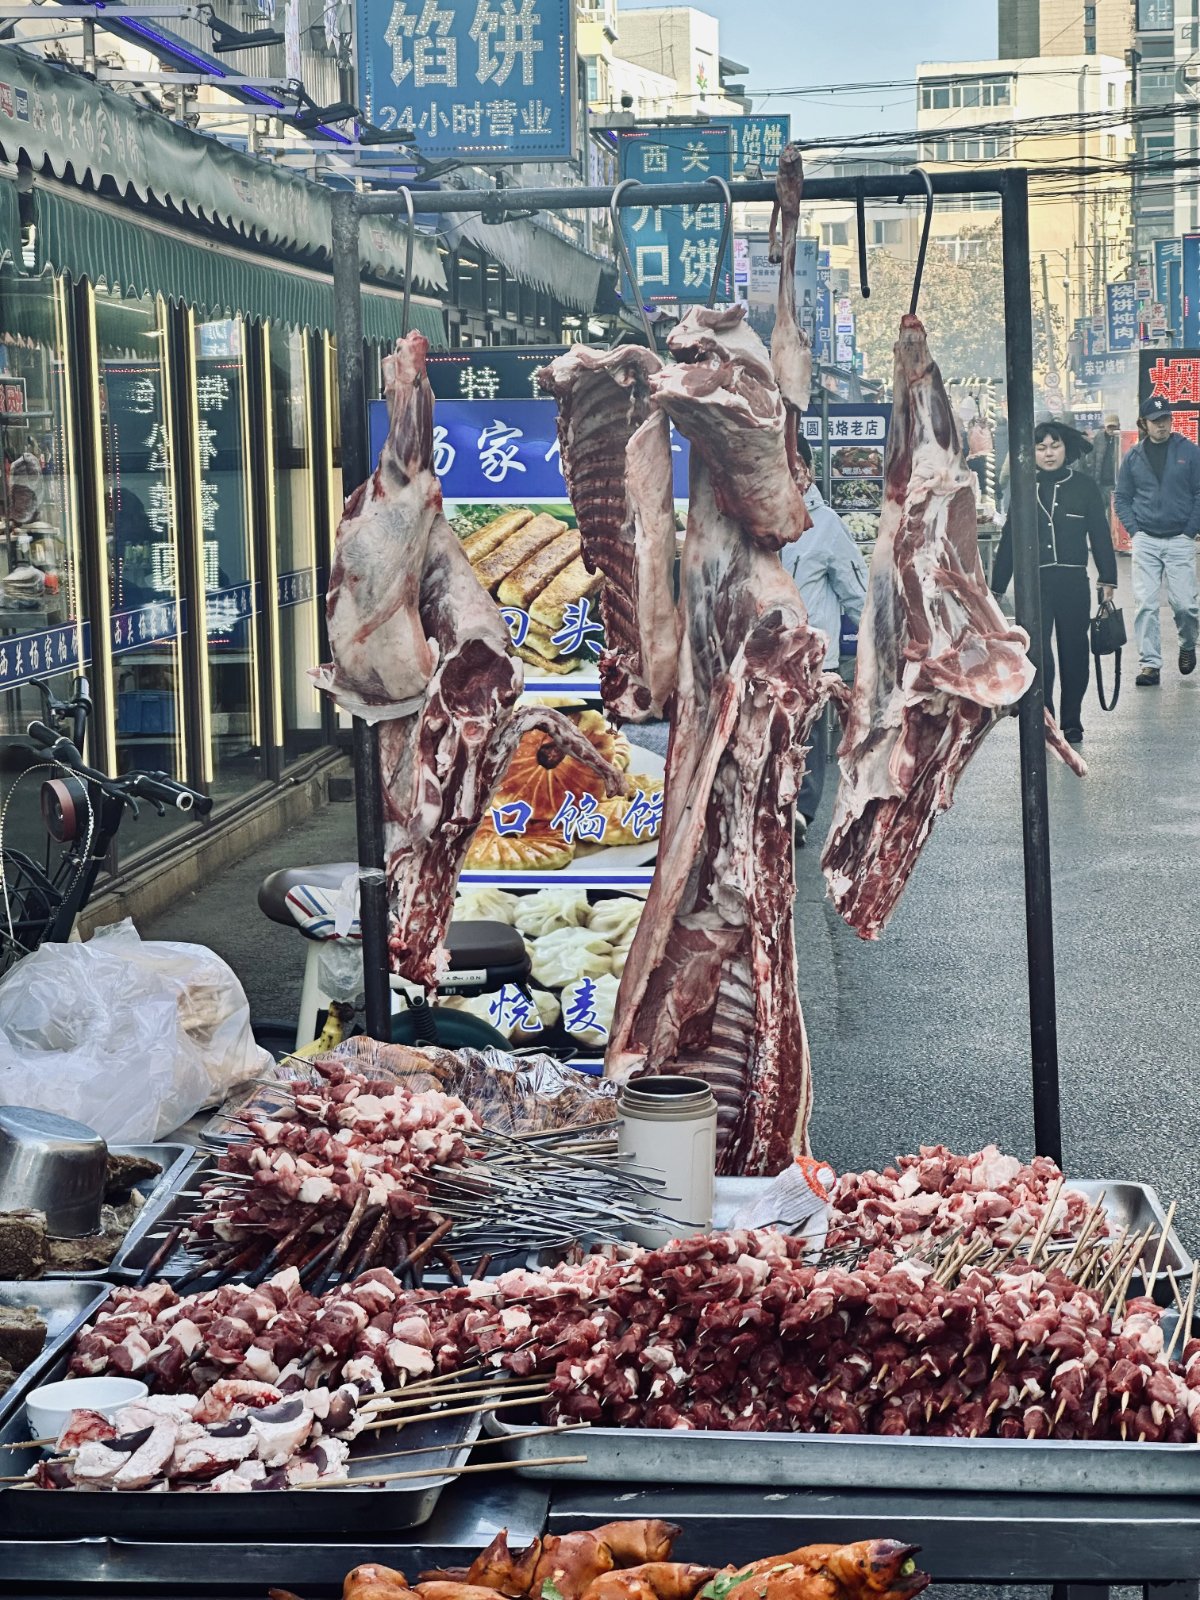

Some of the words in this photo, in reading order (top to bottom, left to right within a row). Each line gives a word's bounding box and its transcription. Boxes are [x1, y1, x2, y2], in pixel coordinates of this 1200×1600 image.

[384, 0, 543, 88] 馅饼
[379, 100, 552, 138] 24小时营业
[640, 142, 710, 173] 西关
[1111, 285, 1135, 339] 烧饼炖肉
[459, 366, 500, 399] 特
[490, 789, 662, 844] 口馅饼
[488, 977, 607, 1032] 烧麦
